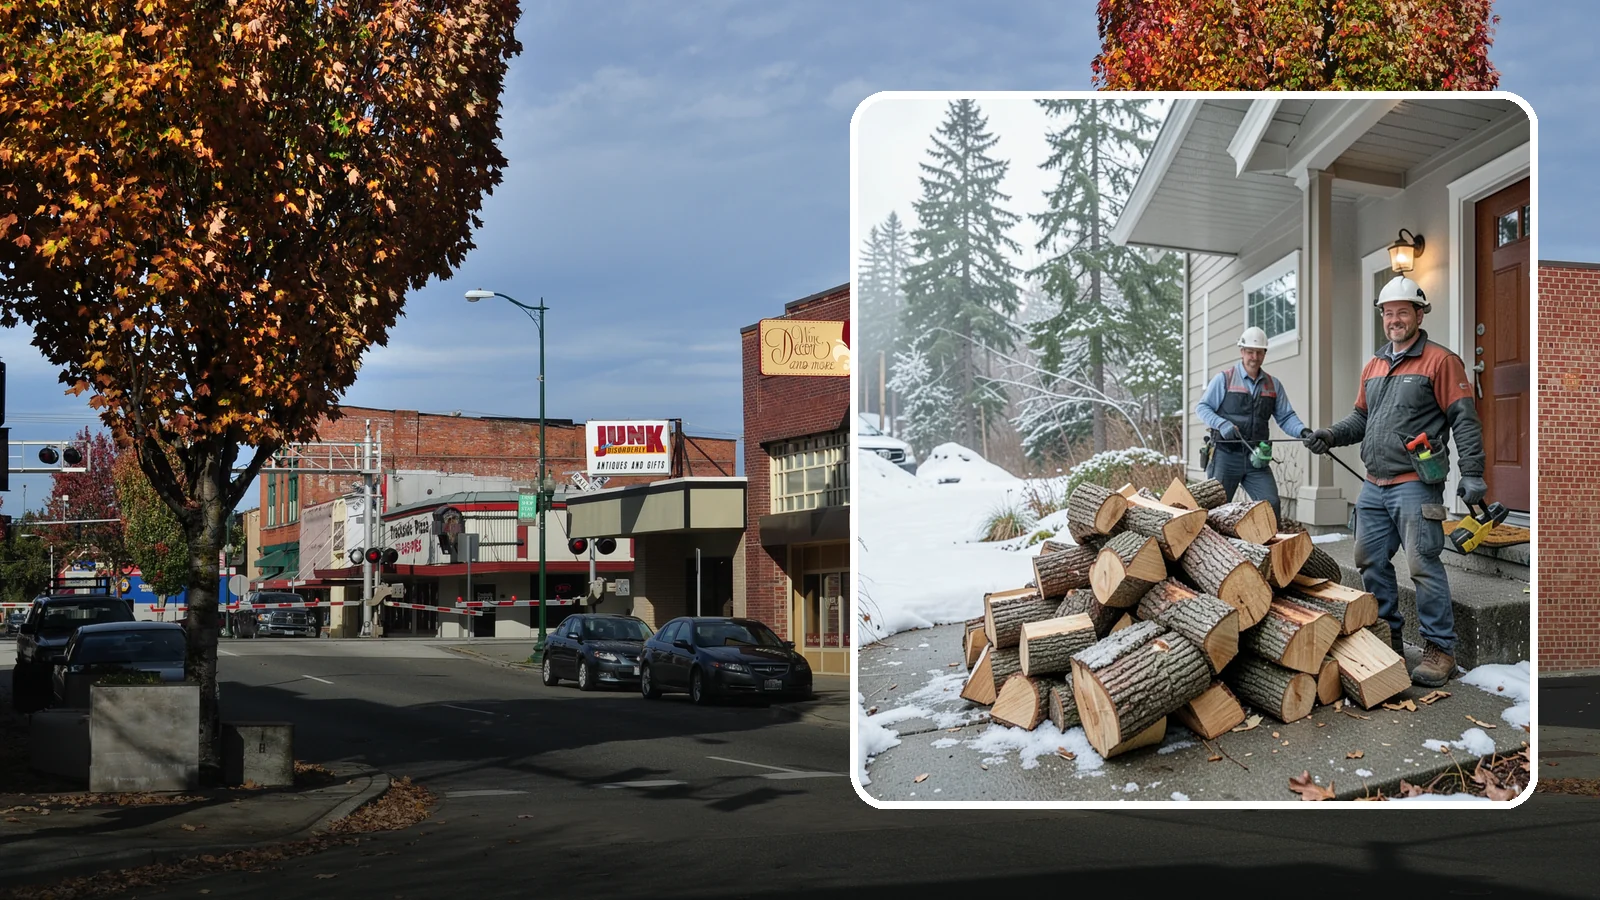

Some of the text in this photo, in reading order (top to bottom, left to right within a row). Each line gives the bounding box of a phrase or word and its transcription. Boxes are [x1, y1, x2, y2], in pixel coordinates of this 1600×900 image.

[595, 425, 665, 457] JUNK
[607, 446, 646, 454] DISORDERLY
[597, 460, 666, 470] ANTIQUES AND GIFTS
[390, 519, 429, 540] Trackside Pizza
